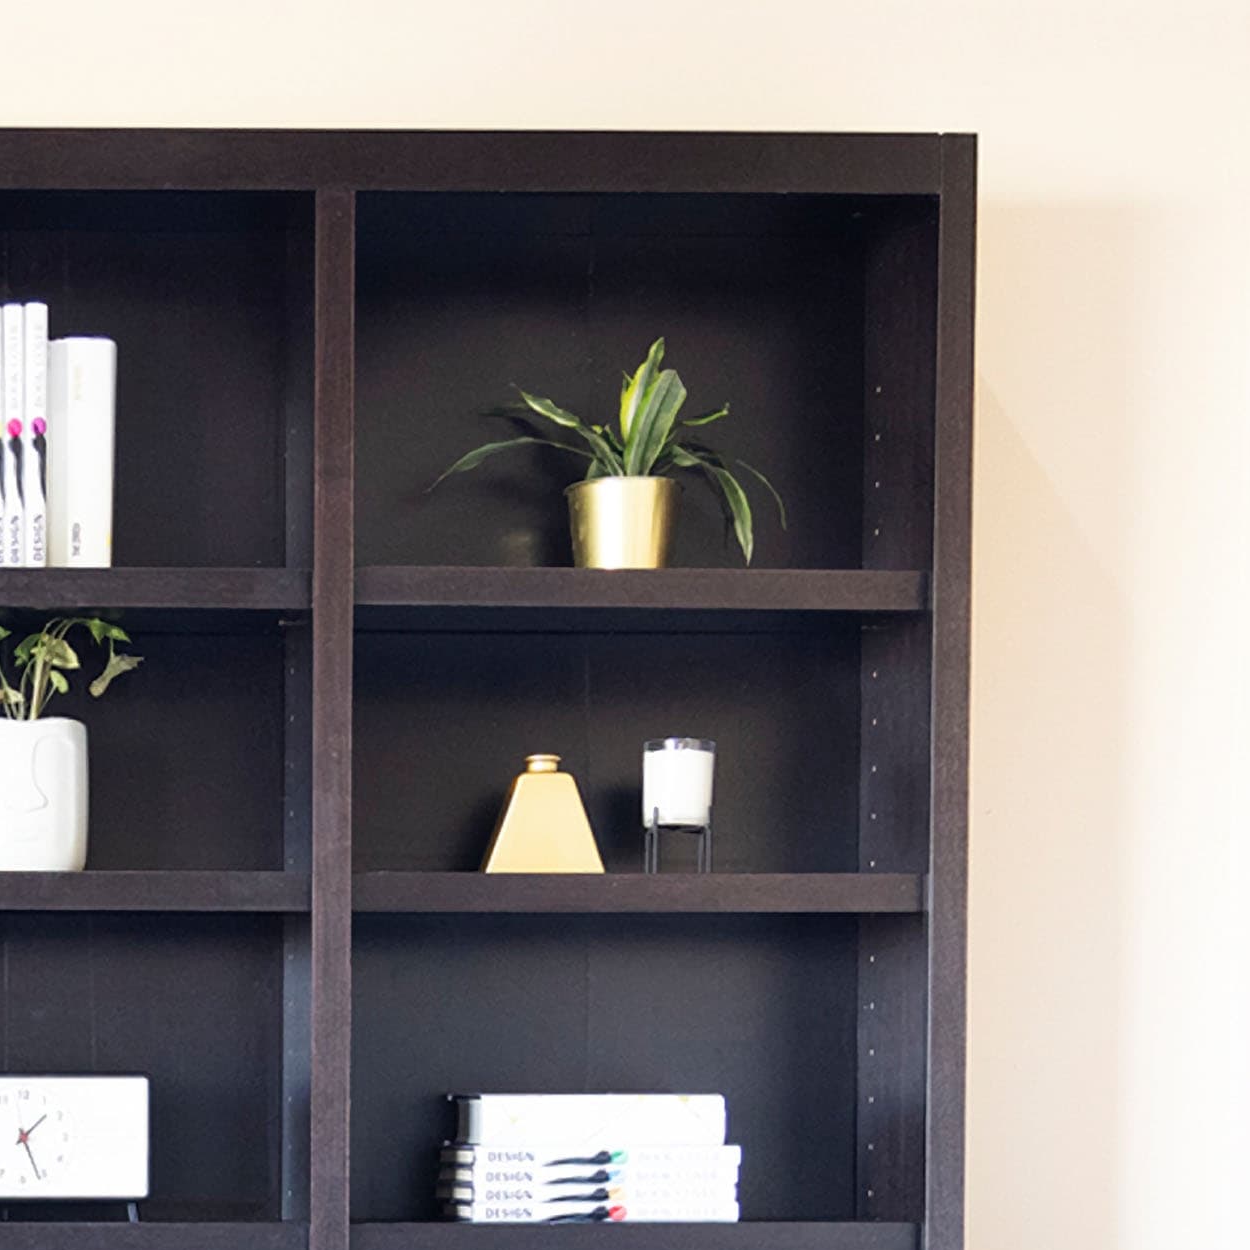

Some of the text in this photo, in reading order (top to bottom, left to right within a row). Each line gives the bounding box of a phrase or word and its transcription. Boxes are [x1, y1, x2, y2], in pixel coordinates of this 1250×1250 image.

[487, 1151, 535, 1162] DESIGN
[485, 1171, 533, 1182] DESIGN
[485, 1189, 533, 1201] DESIGN
[485, 1207, 532, 1219] DESIGN
